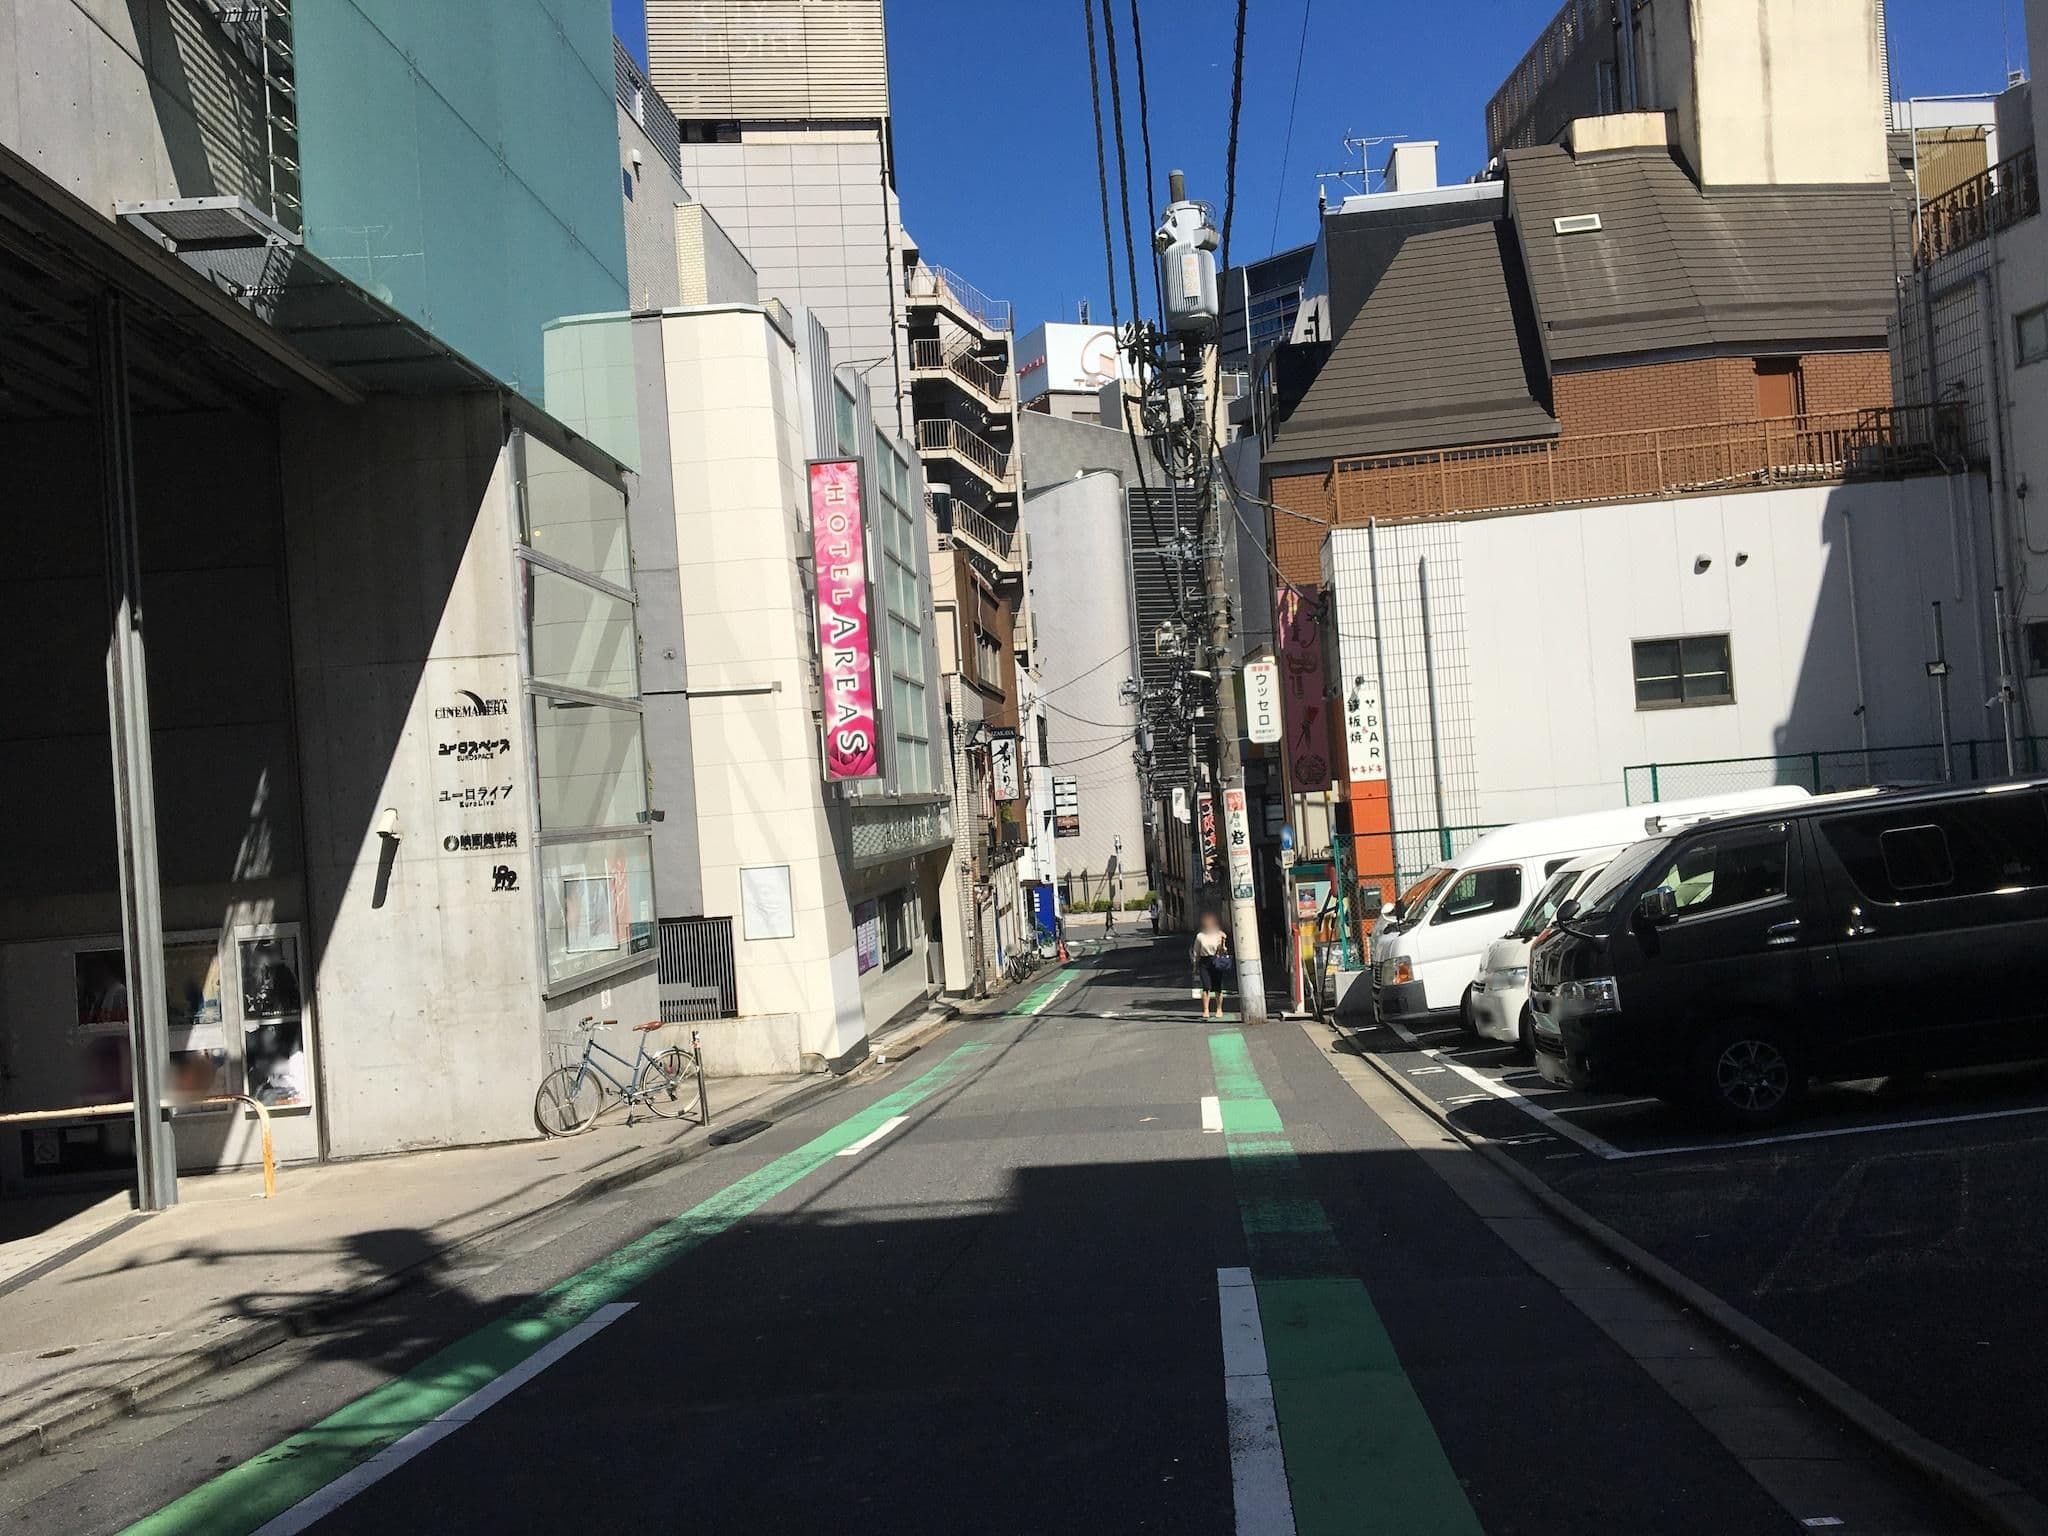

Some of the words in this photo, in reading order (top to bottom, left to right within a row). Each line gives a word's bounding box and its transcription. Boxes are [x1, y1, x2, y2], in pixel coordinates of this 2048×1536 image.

[826, 486, 853, 605] HOTEL
[832, 616, 866, 753] AREAS
[438, 739, 510, 755] ユーロスペース
[456, 752, 494, 762] EUROSPACE
[1367, 715, 1380, 758] BAR
